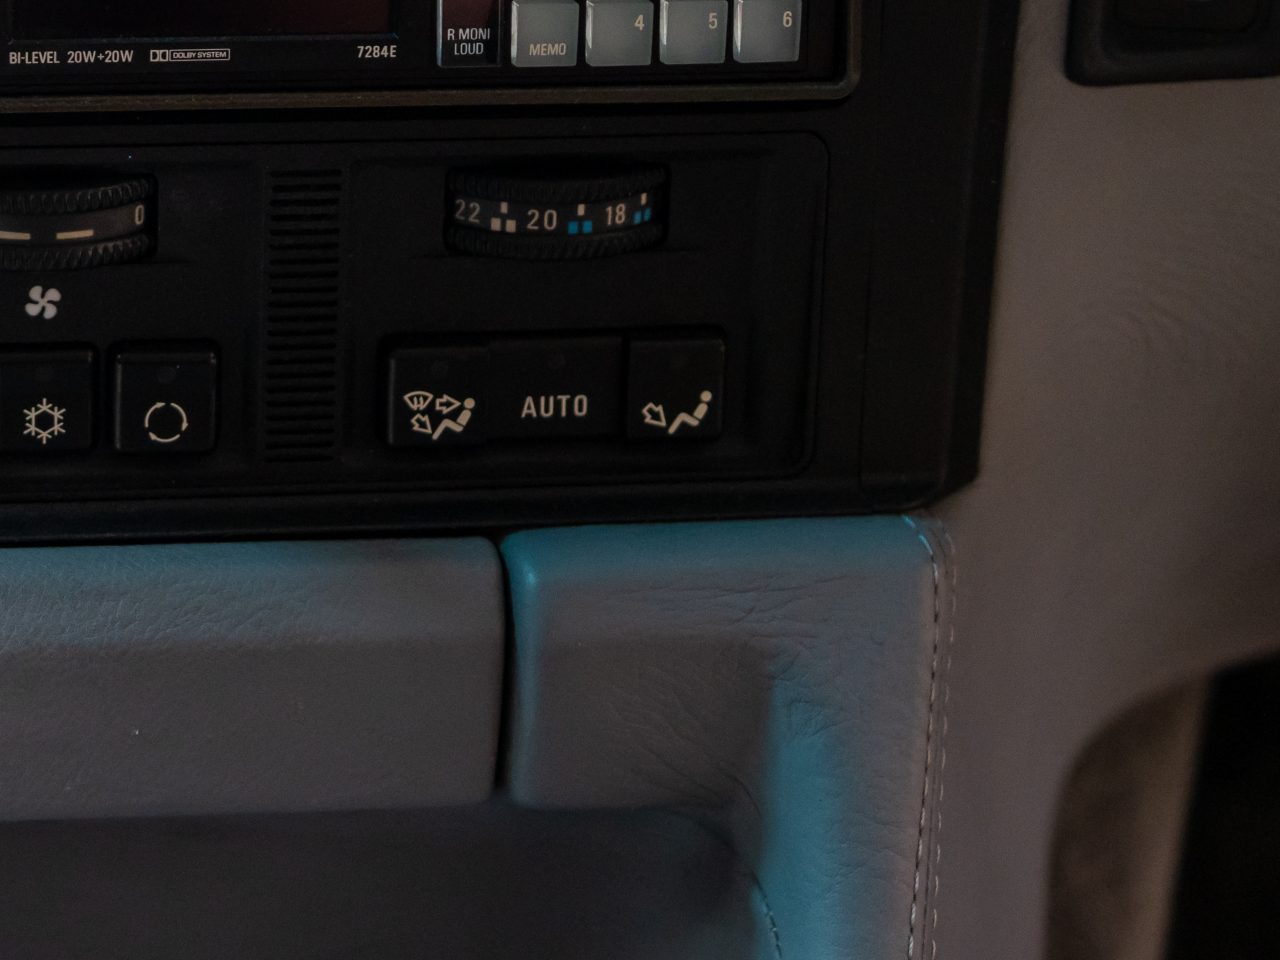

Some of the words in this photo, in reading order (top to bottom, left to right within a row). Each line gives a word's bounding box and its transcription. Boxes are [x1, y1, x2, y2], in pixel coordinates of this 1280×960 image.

[634, 14, 645, 31] 4
[708, 13, 718, 30] 5
[782, 11, 793, 28] 6
[447, 28, 455, 41] R
[459, 27, 490, 41] MONI
[8, 50, 61, 65] BI-LEVEL
[66, 49, 134, 64] 20W+20W
[197, 50, 227, 58] SYSTEM
[356, 45, 398, 59] 7284E
[454, 42, 484, 56] LOUD
[529, 42, 567, 56] MEMO
[134, 204, 145, 226] 0
[454, 199, 481, 223] 22
[526, 208, 558, 231] 20
[605, 203, 627, 226] 18
[520, 394, 589, 419] AUTO
